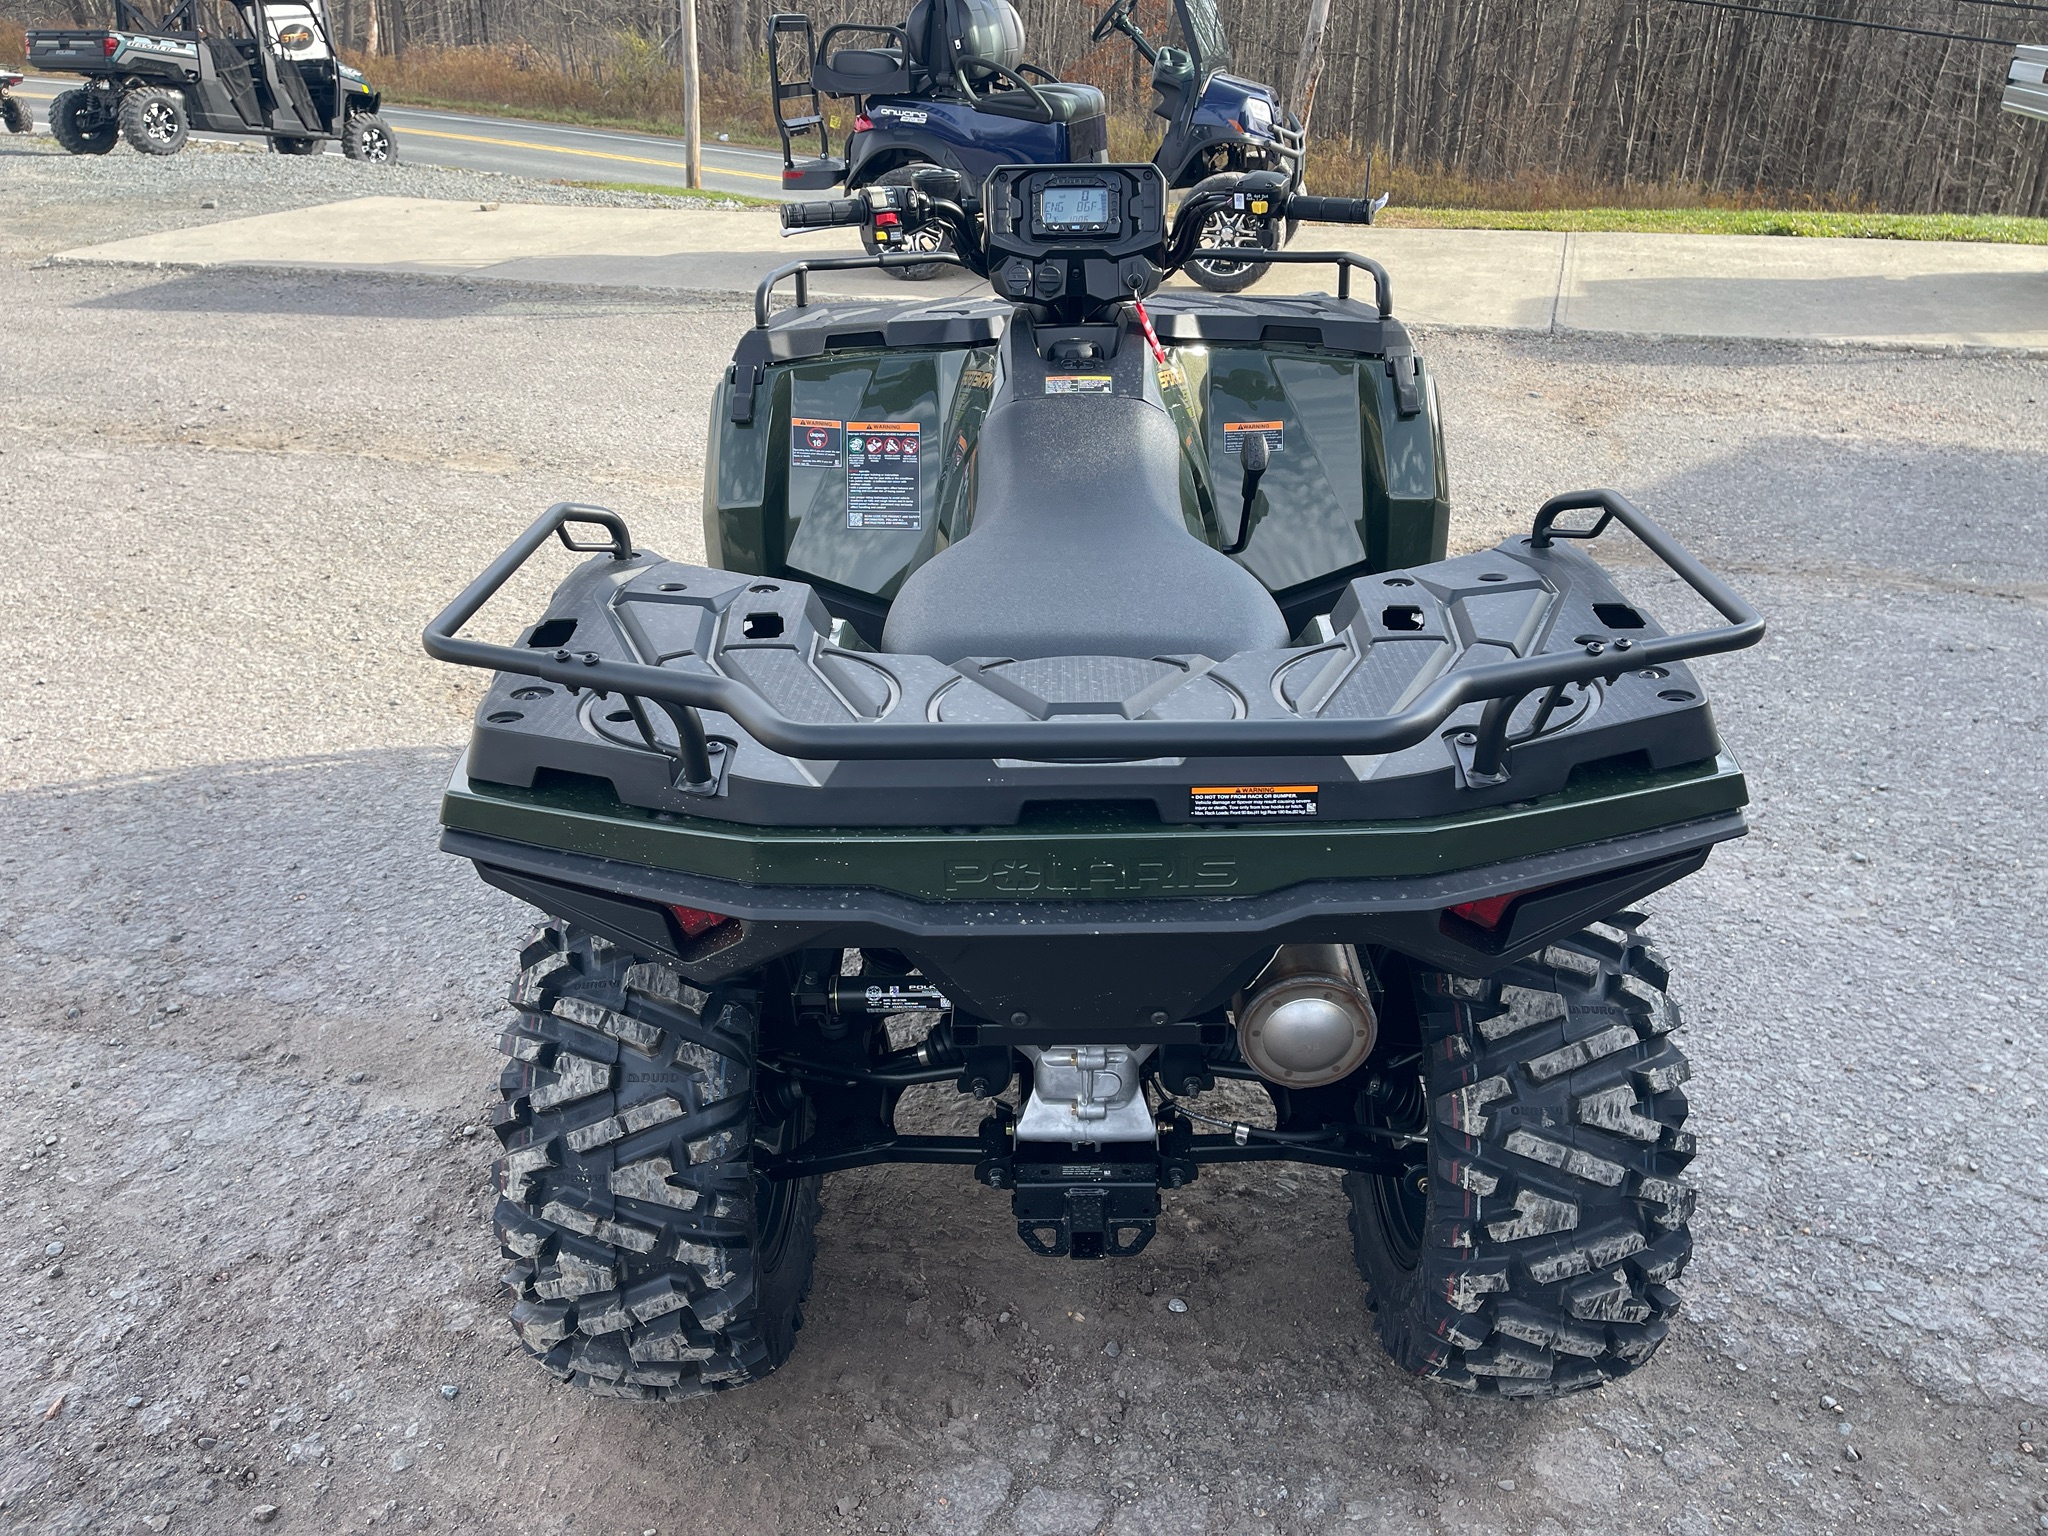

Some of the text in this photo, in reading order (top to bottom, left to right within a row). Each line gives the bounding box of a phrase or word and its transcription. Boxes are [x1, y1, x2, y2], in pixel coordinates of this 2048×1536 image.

[1045, 202, 1064, 212] ENG
[812, 439, 822, 447] 16
[945, 856, 1238, 891] POLARIS
